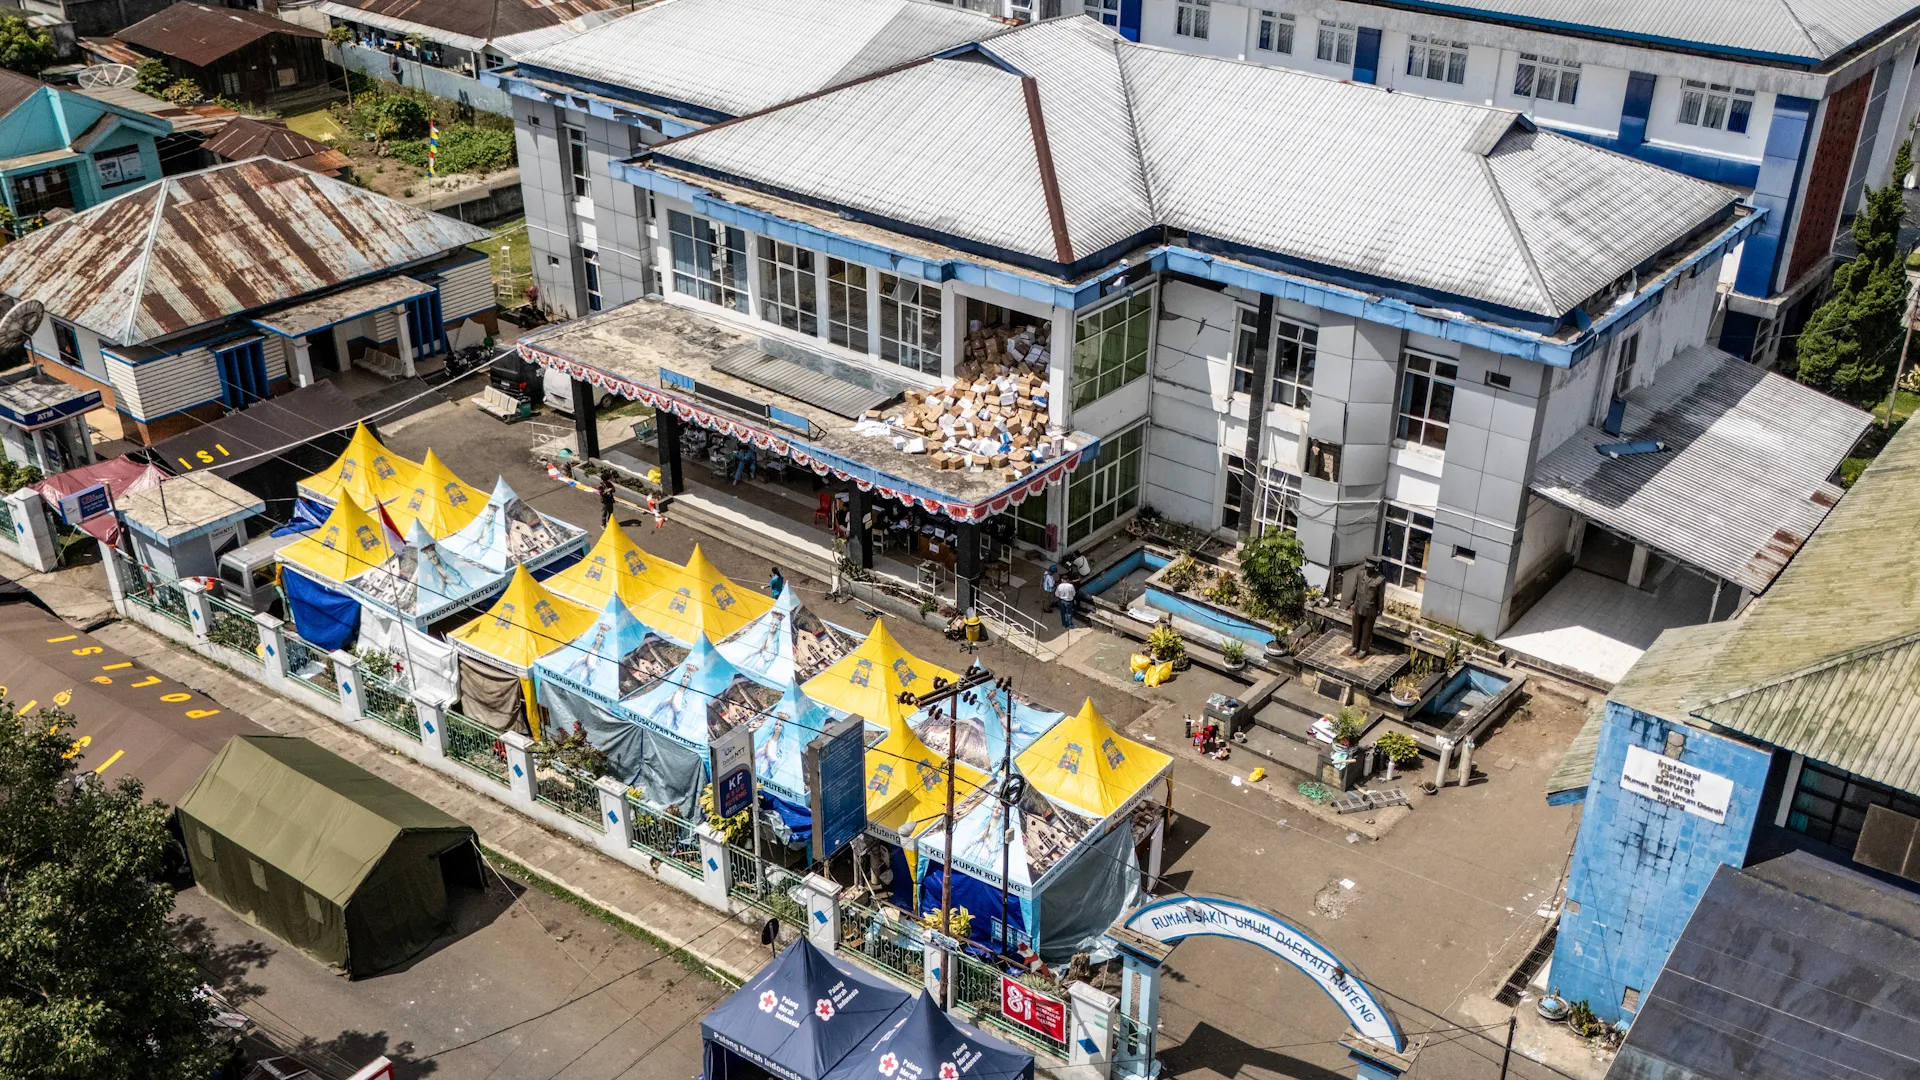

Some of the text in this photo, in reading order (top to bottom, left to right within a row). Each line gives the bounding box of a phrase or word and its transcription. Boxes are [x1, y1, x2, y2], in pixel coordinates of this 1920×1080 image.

[37, 410, 54, 421] ATM
[426, 597, 470, 621] KEUSKUPAN
[471, 583, 499, 600] RUTENG
[47, 634, 220, 719] POLISI
[543, 669, 608, 703] KEUSKUPAN RUTENG
[628, 712, 669, 735] KEUSKUPAN
[722, 746, 746, 766] bankNTT
[729, 772, 743, 790] KF
[1657, 759, 1701, 783] Instalasi
[1660, 769, 1694, 788] Gawat
[763, 780, 793, 798] RUTENG
[1623, 774, 1724, 817] Rumah Sakit Umum Daerah
[1655, 775, 1696, 798] Darurat
[1113, 789, 1146, 820] Keuskupan
[1657, 794, 1686, 812] Ruteng
[870, 823, 900, 844] Ruteng
[984, 872, 1021, 892] RUTNG
[1151, 908, 1376, 1023] RUMAH SAKIT UMUM DAERAH RUTENG
[828, 980, 844, 996] Palang
[832, 988, 848, 1003] Merah
[781, 995, 800, 1010] Palang
[836, 988, 859, 1010] Indonesia
[1007, 985, 1032, 1020] 81
[774, 1011, 800, 1029] Indonesia
[778, 1003, 795, 1017] Merah
[713, 1031, 802, 1080] Palang Merah Indonesia
[952, 1042, 968, 1059] Palang
[956, 1050, 972, 1067] Merah
[902, 1058, 923, 1075] Palang
[961, 1051, 983, 1074] Indonesia
[899, 1067, 918, 1080] Merah
